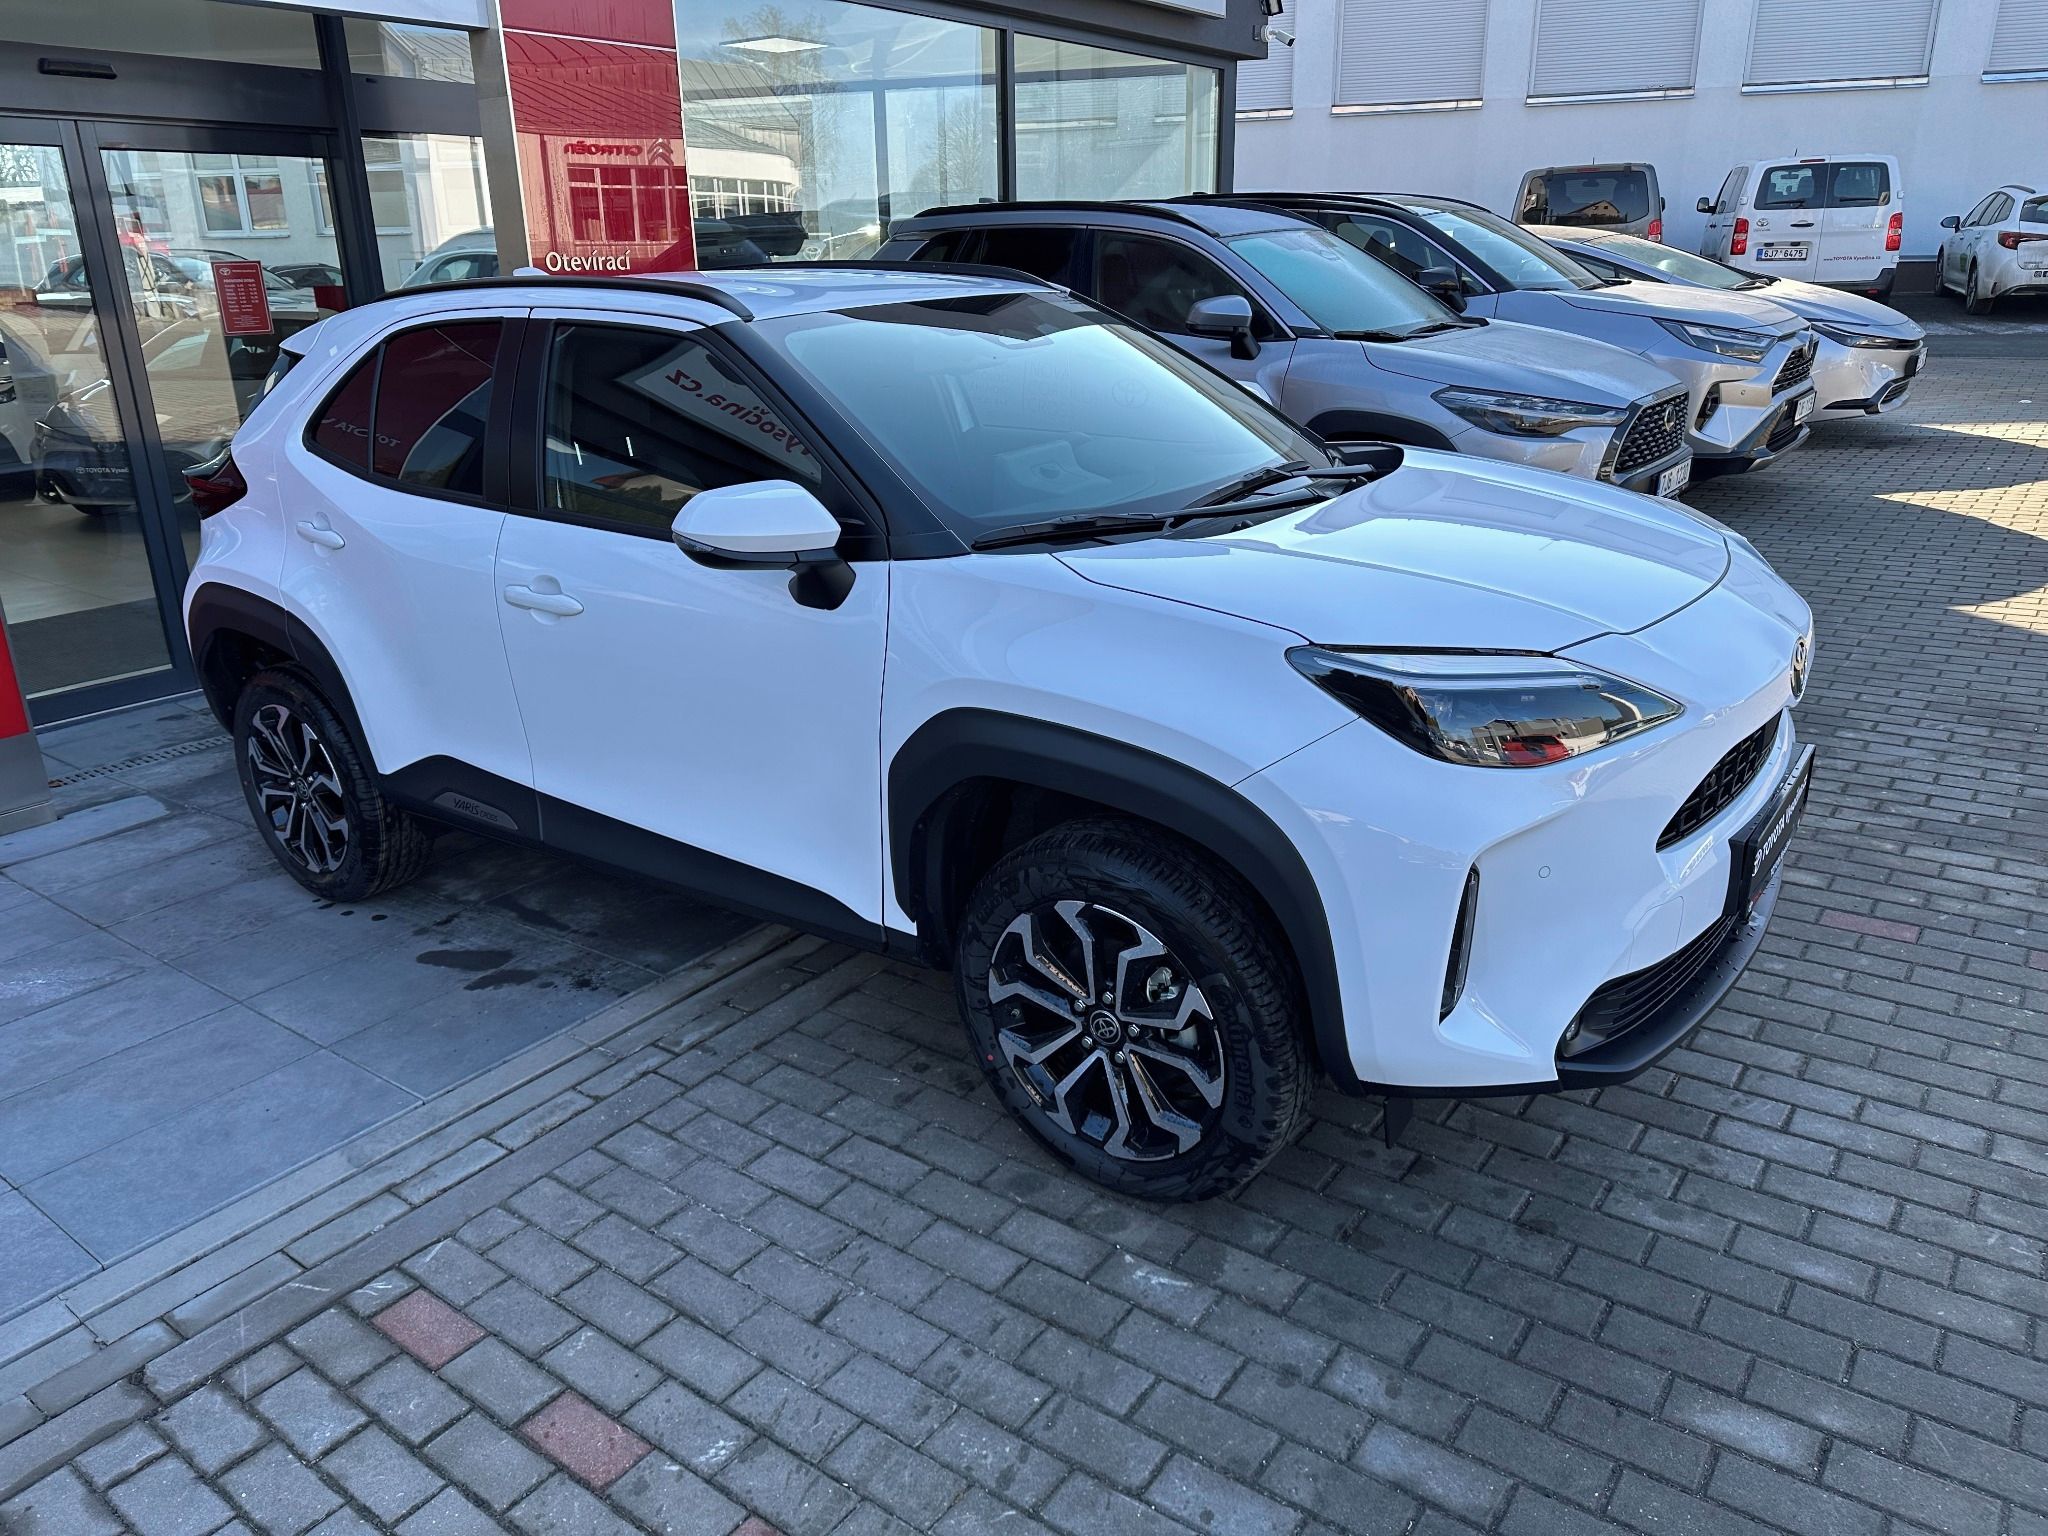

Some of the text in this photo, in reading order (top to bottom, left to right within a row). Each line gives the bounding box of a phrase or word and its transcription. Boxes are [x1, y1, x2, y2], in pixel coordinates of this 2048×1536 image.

[545, 249, 631, 272] Otevírací
[1764, 249, 1804, 258] 6J7 6475
[454, 798, 479, 815] YARIS
